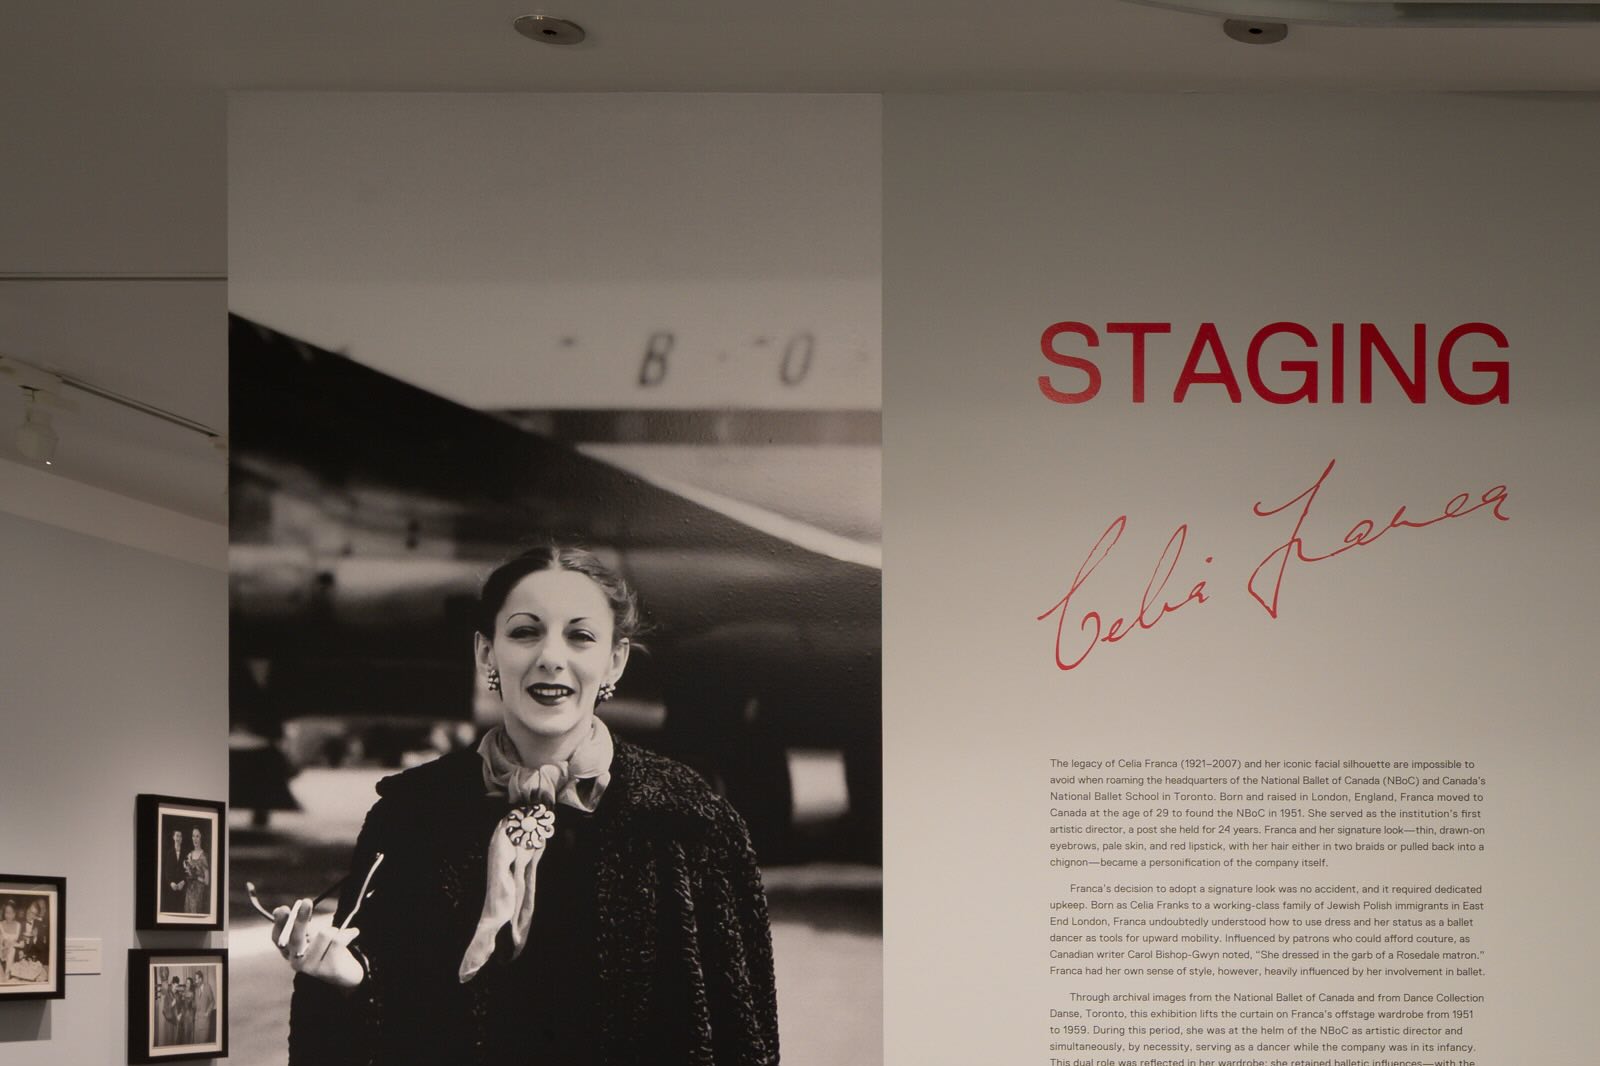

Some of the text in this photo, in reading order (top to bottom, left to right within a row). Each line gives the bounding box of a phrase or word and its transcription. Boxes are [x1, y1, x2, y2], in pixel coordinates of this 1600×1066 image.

[1037, 321, 1510, 405] STAGING
[1038, 516, 1213, 670] Celia
[1050, 759, 1068, 767] The
[1072, 760, 1102, 769] legacy
[1118, 759, 1142, 767] Celia
[1145, 759, 1177, 767] Franca
[1244, 760, 1262, 768] and
[1265, 760, 1281, 768] her
[1284, 760, 1311, 768] iconic
[1315, 760, 1340, 768] facial
[1343, 760, 1390, 768] silhouette
[1412, 760, 1462, 770] impossible
[1051, 792, 1091, 800] National
[1095, 792, 1122, 800] Ballet
[1126, 792, 1159, 800] School
[1162, 791, 1170, 800] in
[1174, 792, 1216, 800] Toronto.
[1220, 792, 1243, 801] Born
[1267, 793, 1296, 801] raised
[1300, 792, 1308, 800] in
[1312, 793, 1351, 801] London,
[1355, 793, 1397, 803] England,
[1401, 793, 1434, 801] Franca
[1050, 917, 1068, 925] End
[1072, 918, 1110, 926] London,
[1114, 917, 1146, 925] Franca
[1149, 918, 1208, 927] undoubtedly
[1212, 918, 1266, 926] understood
[1269, 918, 1289, 926] how
[1325, 918, 1351, 926] dress
[1354, 918, 1371, 926] and
[1374, 918, 1389, 926] her
[1447, 918, 1473, 926] ballet
[1050, 966, 1082, 975] Franca
[1085, 967, 1103, 975] had
[1106, 967, 1121, 975] her
[1177, 967, 1187, 975] of
[1189, 967, 1214, 976] style,
[1218, 968, 1261, 976] however,
[1265, 967, 1297, 977] heavily
[1300, 967, 1349, 975] influenced
[1352, 968, 1364, 977] by
[1446, 965, 1454, 975] in
[1457, 968, 1485, 976] ballet.
[1063, 1026, 1089, 1034] 1959.
[1093, 1026, 1125, 1036] During
[1128, 1026, 1146, 1034] this
[1149, 1027, 1183, 1035] period,
[1242, 1026, 1258, 1034] the
[1261, 1026, 1284, 1034] helm
[1287, 1026, 1298, 1034] of
[1320, 1026, 1348, 1034] NBoC
[1366, 1027, 1400, 1035] artistic
[1403, 1027, 1442, 1035] director
[1445, 1027, 1462, 1035] and
[1050, 1042, 1125, 1052] simultaneously,
[1129, 1043, 1140, 1052] by
[1144, 1044, 1192, 1052] necessity,
[1196, 1045, 1231, 1053] serving
[1257, 1043, 1290, 1051] dancer
[1294, 1043, 1319, 1051] while
[1322, 1043, 1338, 1051] the
[1341, 1045, 1385, 1053] company
[1411, 1042, 1419, 1051] in
[1422, 1042, 1434, 1051] its
[1437, 1043, 1476, 1053] infancy.
